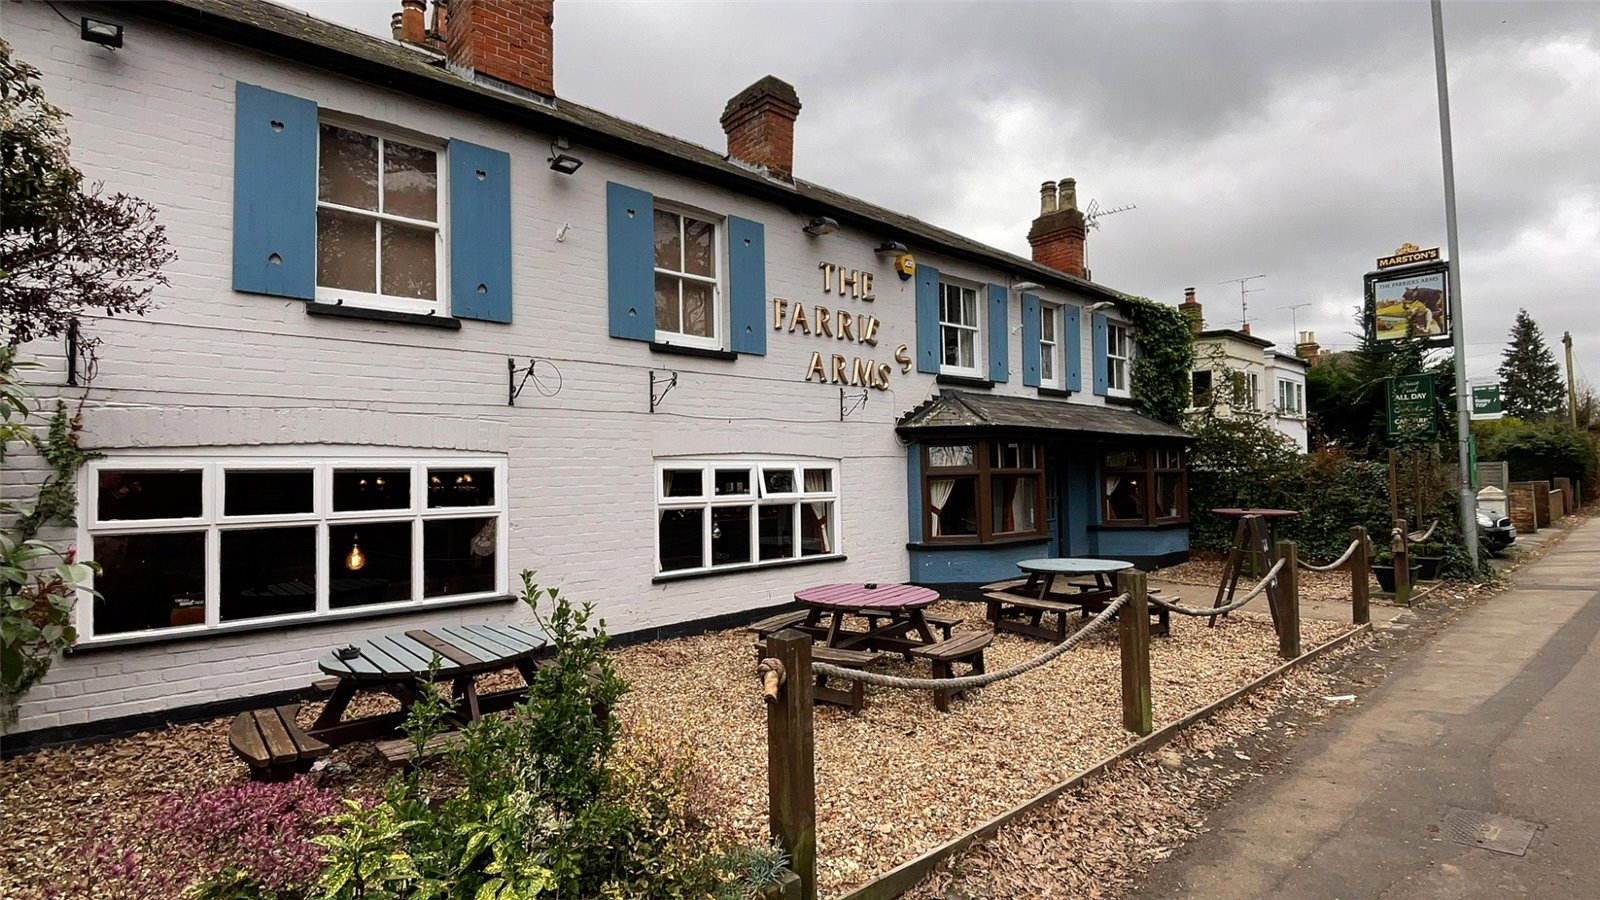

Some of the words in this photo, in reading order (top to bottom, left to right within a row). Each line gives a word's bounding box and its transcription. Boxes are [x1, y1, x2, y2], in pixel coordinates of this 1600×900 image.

[1379, 250, 1437, 267] MARSTON'S
[819, 261, 875, 302] THE
[805, 351, 892, 391] ARMS
[1411, 392, 1427, 400] DAY
